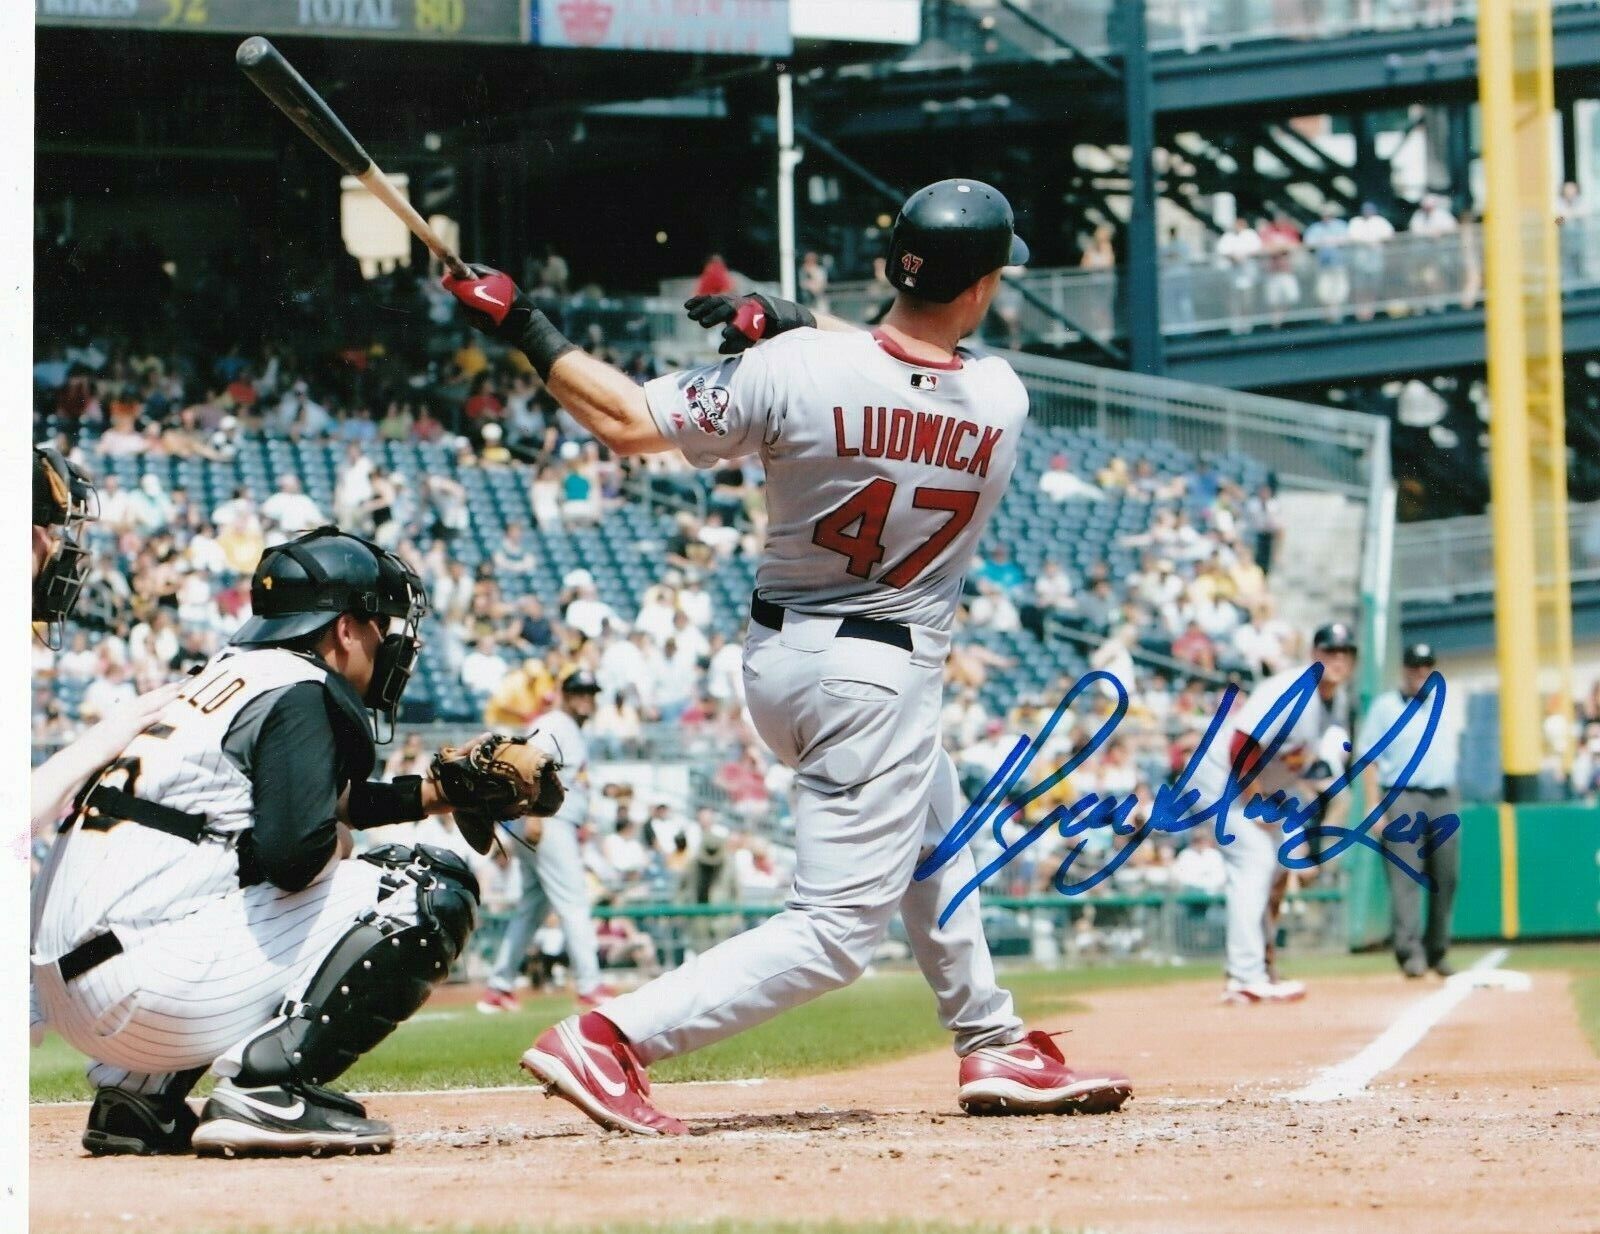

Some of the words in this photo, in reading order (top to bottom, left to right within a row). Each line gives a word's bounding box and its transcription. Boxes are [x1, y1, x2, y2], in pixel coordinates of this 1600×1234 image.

[901, 253, 924, 274] 47
[833, 406, 1003, 478] LUDWICK
[812, 477, 980, 589] 47
